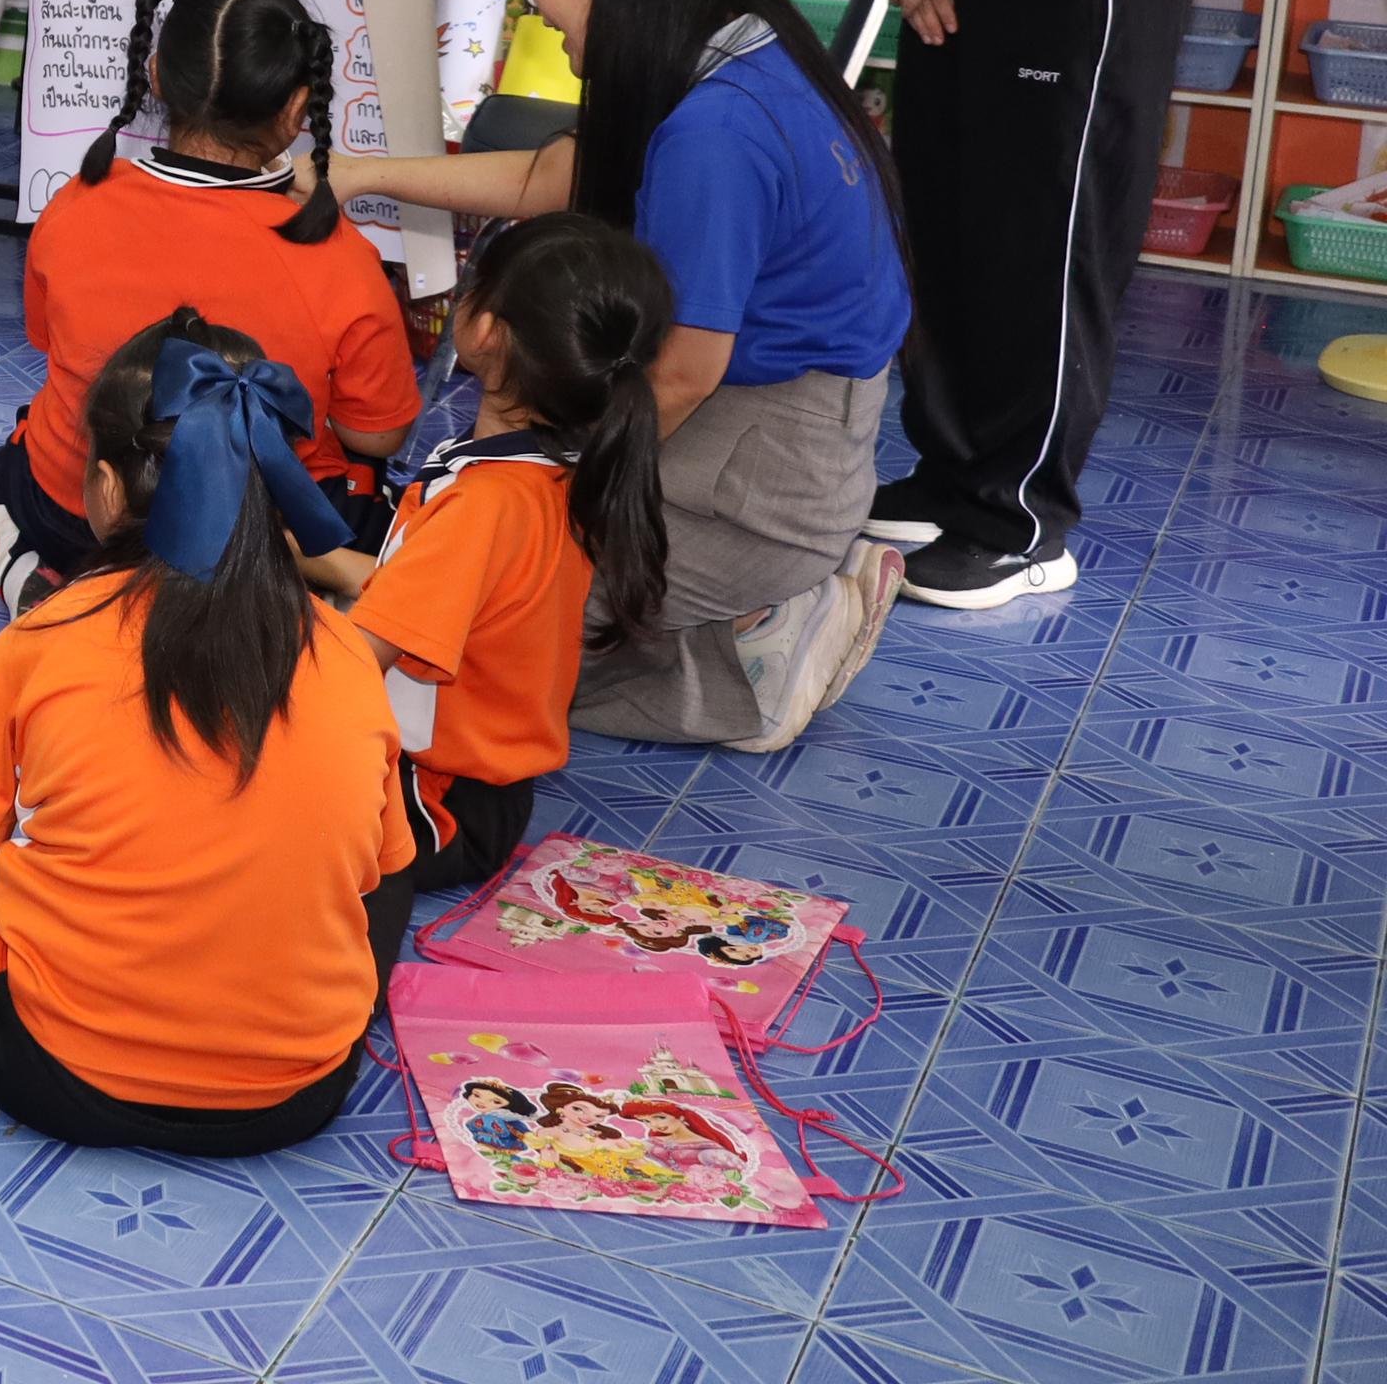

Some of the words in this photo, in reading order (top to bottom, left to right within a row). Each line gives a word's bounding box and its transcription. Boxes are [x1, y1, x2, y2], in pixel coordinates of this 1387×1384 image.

[42, 26, 130, 52] ก้นแก้วกระด
[1018, 68, 1060, 82] SPORT
